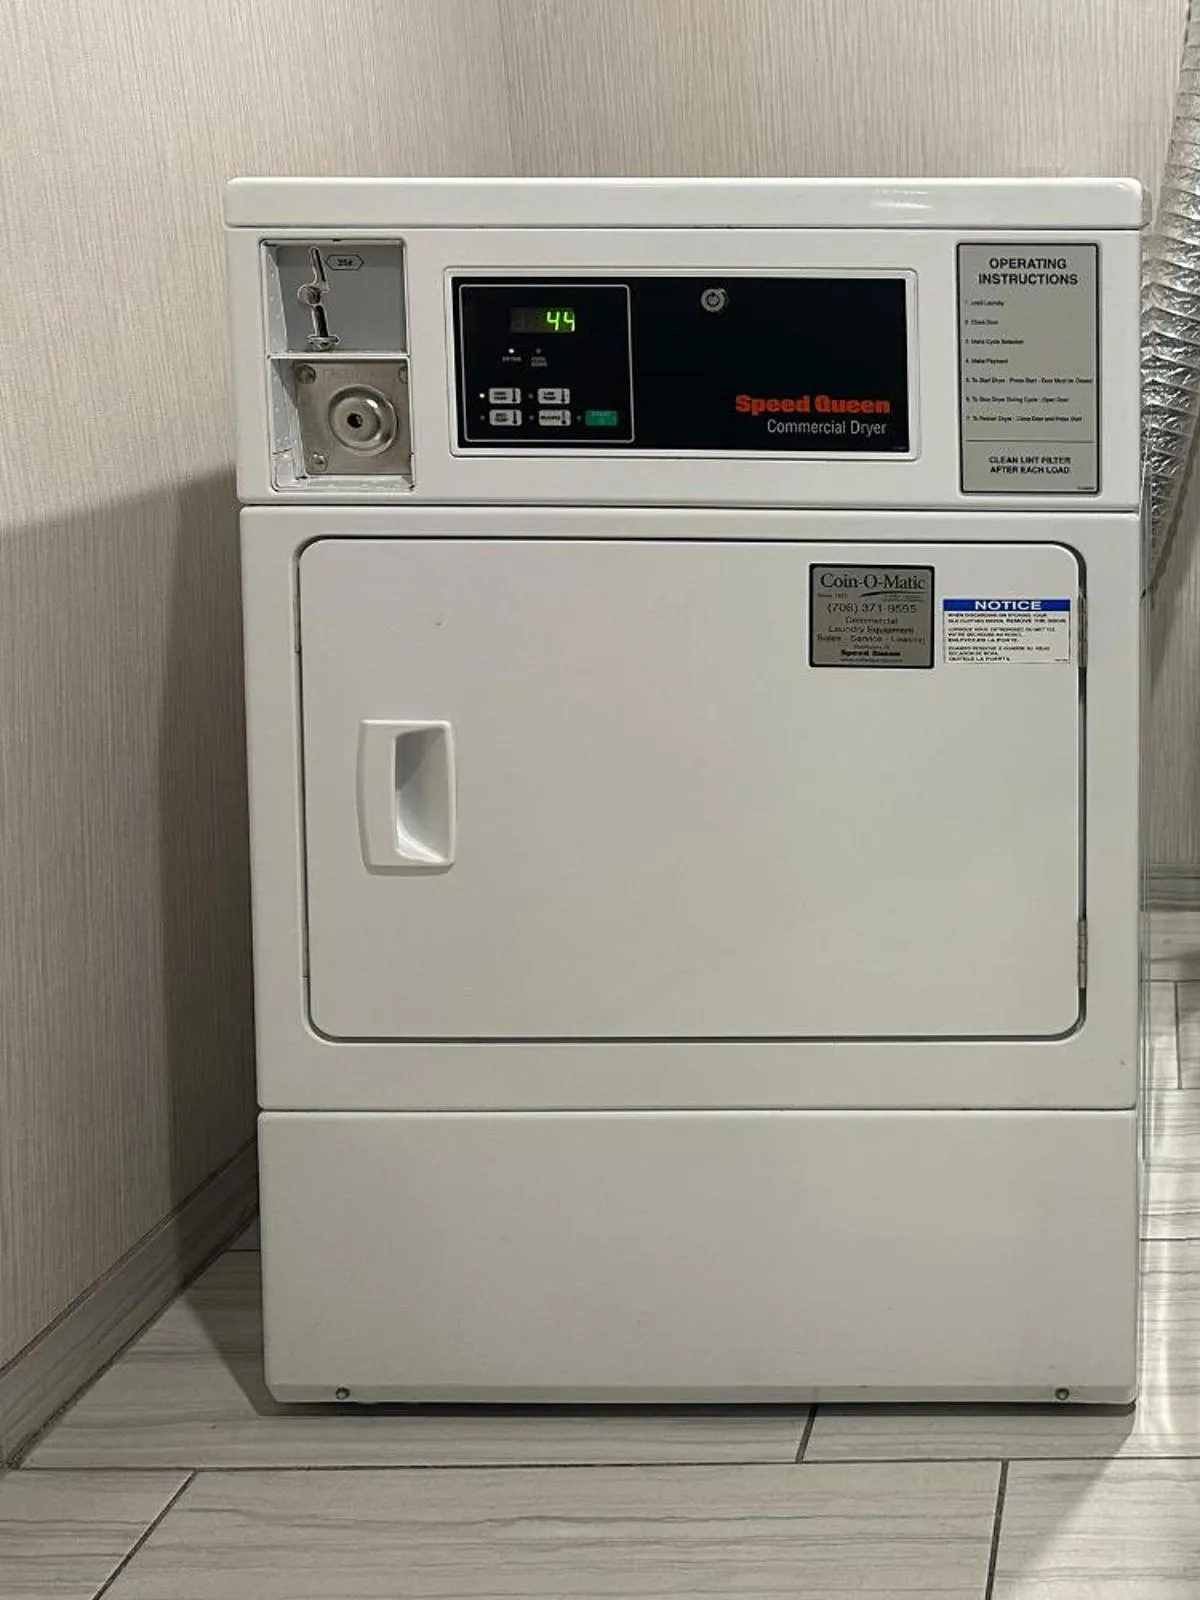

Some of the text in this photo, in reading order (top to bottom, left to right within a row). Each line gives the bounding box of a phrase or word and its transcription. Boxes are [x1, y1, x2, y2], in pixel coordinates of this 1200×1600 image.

[989, 258, 1067, 270] OPERATING
[978, 273, 1078, 285] INSTRUCTIONS
[546, 311, 575, 332] 44
[735, 394, 891, 416] Speed Queen
[767, 418, 887, 437] Commercial Dryer
[989, 456, 1071, 465] CLEAN LINT FILTER
[990, 466, 1070, 474] AFTER EACH LOAD
[820, 572, 926, 590] Coin-O-Matic
[974, 601, 1043, 610] NOTICE
